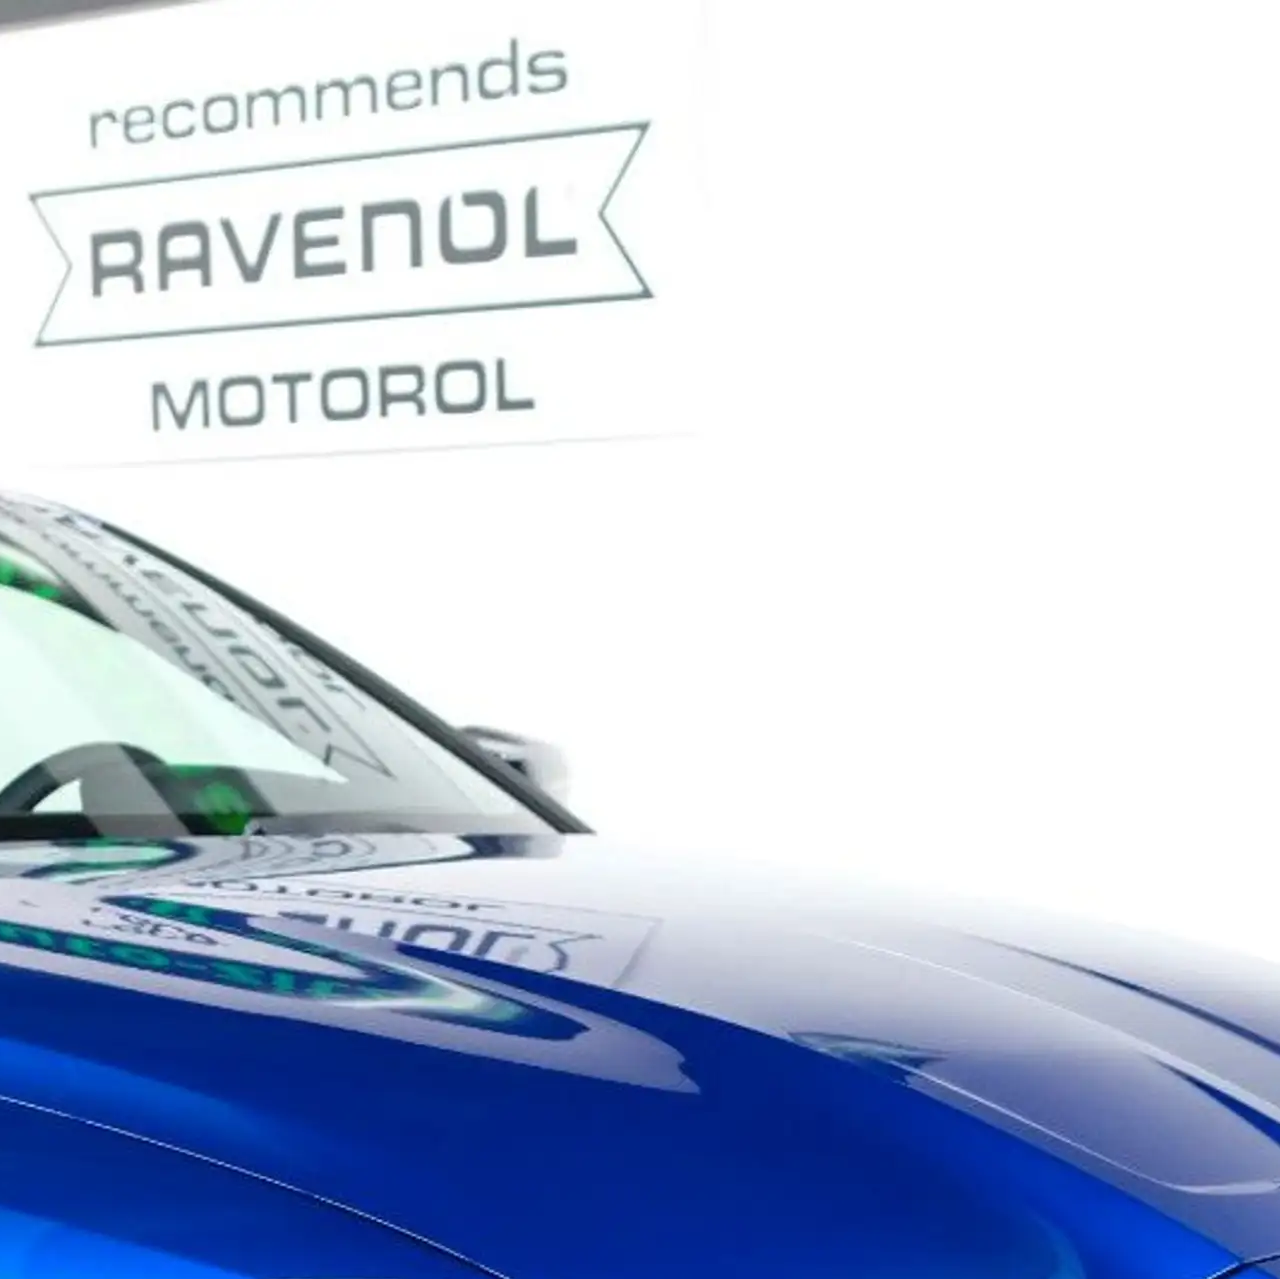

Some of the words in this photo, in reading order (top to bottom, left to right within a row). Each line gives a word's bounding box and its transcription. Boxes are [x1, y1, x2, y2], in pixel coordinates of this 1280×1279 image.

[90, 37, 568, 148] recommends
[90, 185, 578, 298] RAVENOL
[151, 357, 536, 432] MOTOROL
